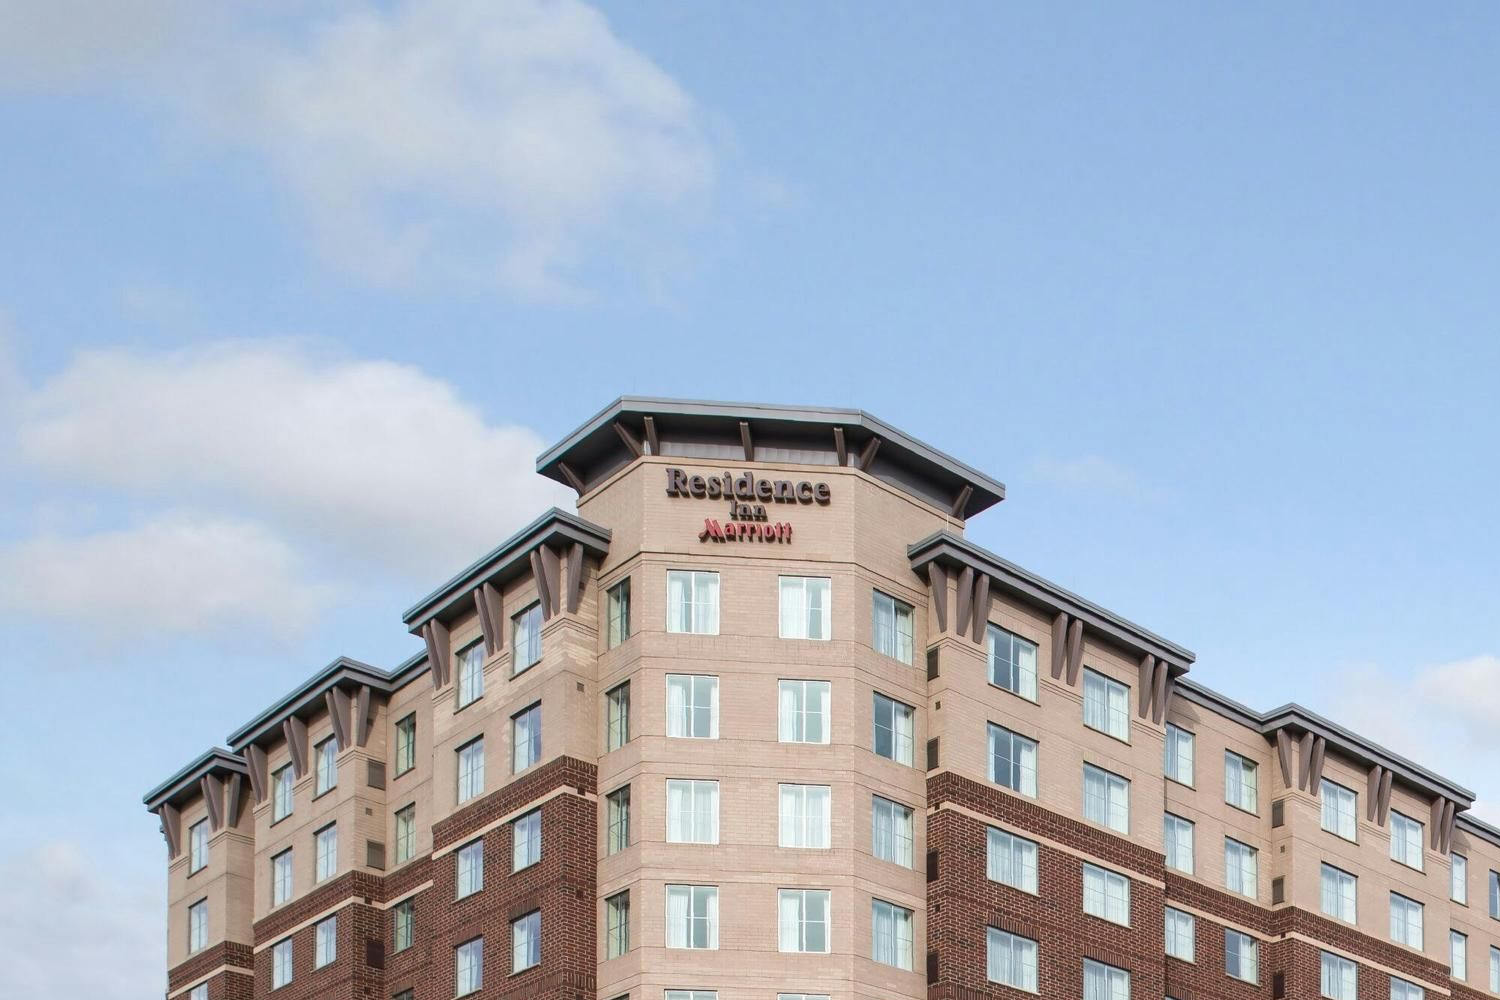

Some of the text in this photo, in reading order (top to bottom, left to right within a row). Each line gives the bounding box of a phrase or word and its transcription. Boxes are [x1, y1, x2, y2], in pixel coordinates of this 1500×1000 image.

[665, 468, 831, 505] Residence
[729, 500, 768, 521] Inn
[699, 517, 793, 544] Marriott
